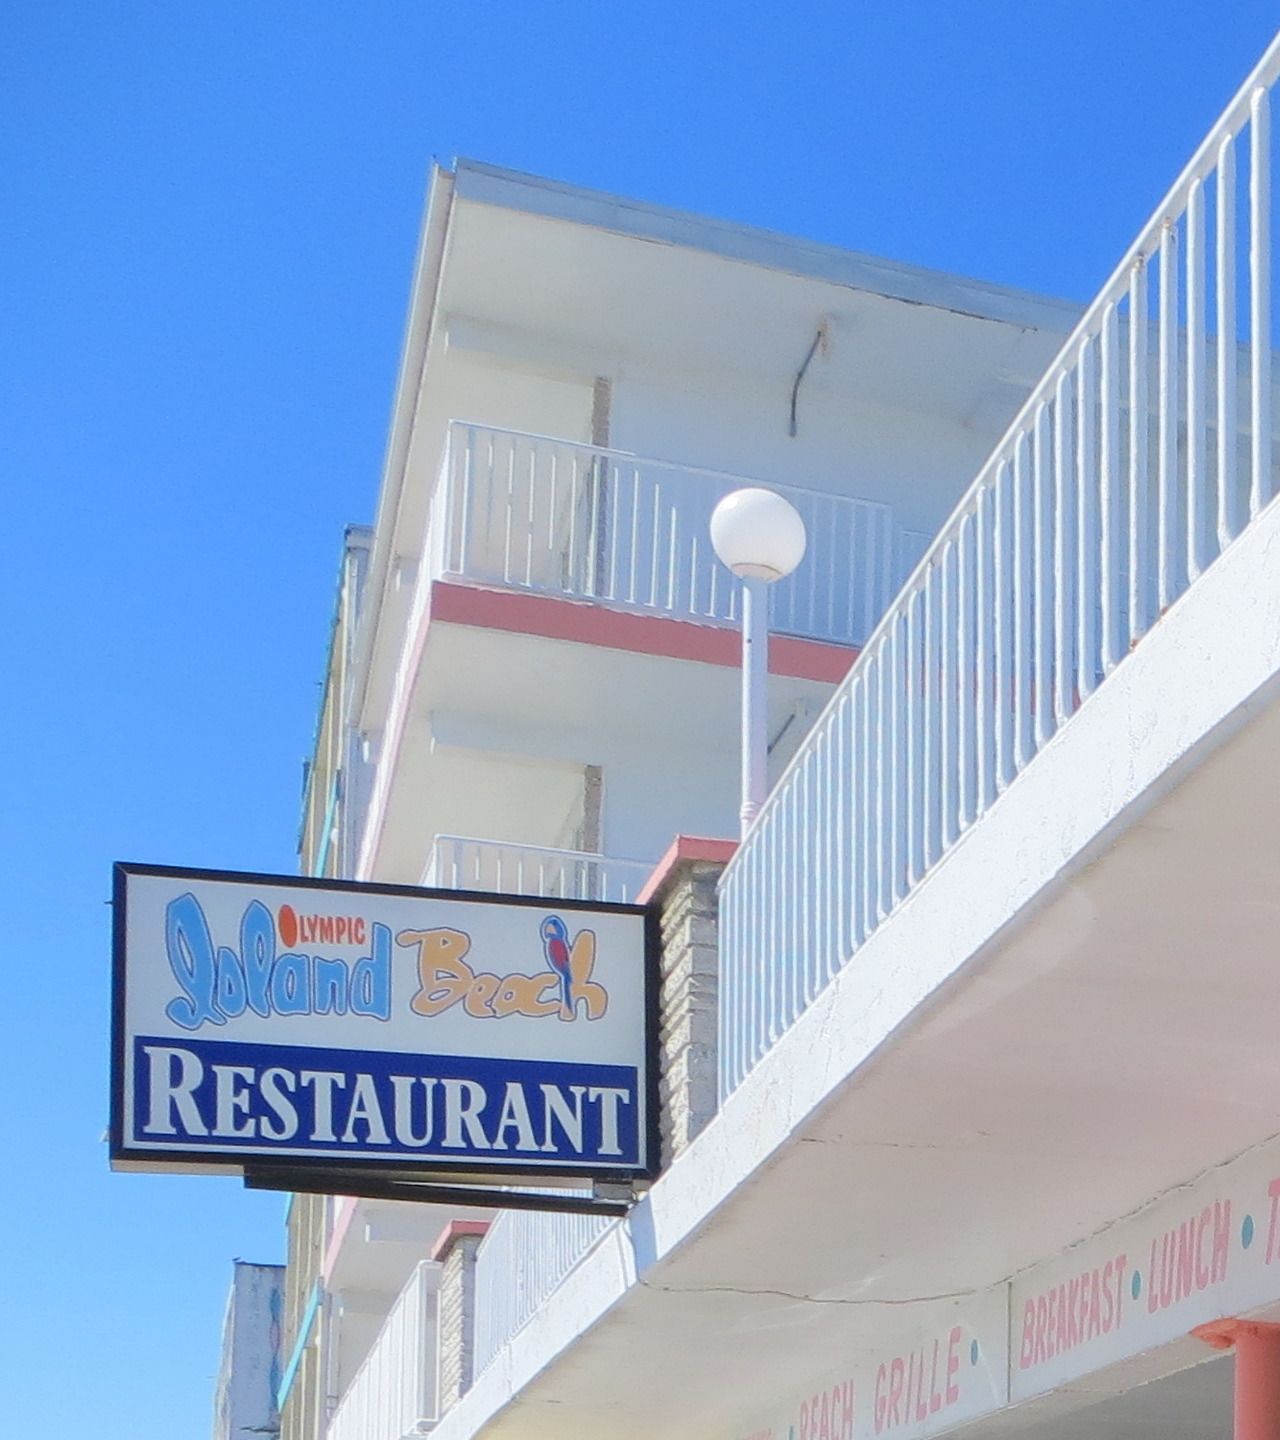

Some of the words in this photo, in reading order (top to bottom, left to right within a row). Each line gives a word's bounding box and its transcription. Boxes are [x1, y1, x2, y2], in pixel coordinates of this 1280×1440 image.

[165, 892, 392, 1031] Island
[396, 925, 609, 1022] Beach
[279, 904, 366, 949] OLYMPIC
[142, 1045, 630, 1156] RESTAURANT
[1019, 1253, 1127, 1371] BREAKFAST
[1147, 1198, 1232, 1315] LUNCH
[873, 1325, 962, 1436] GRILLE
